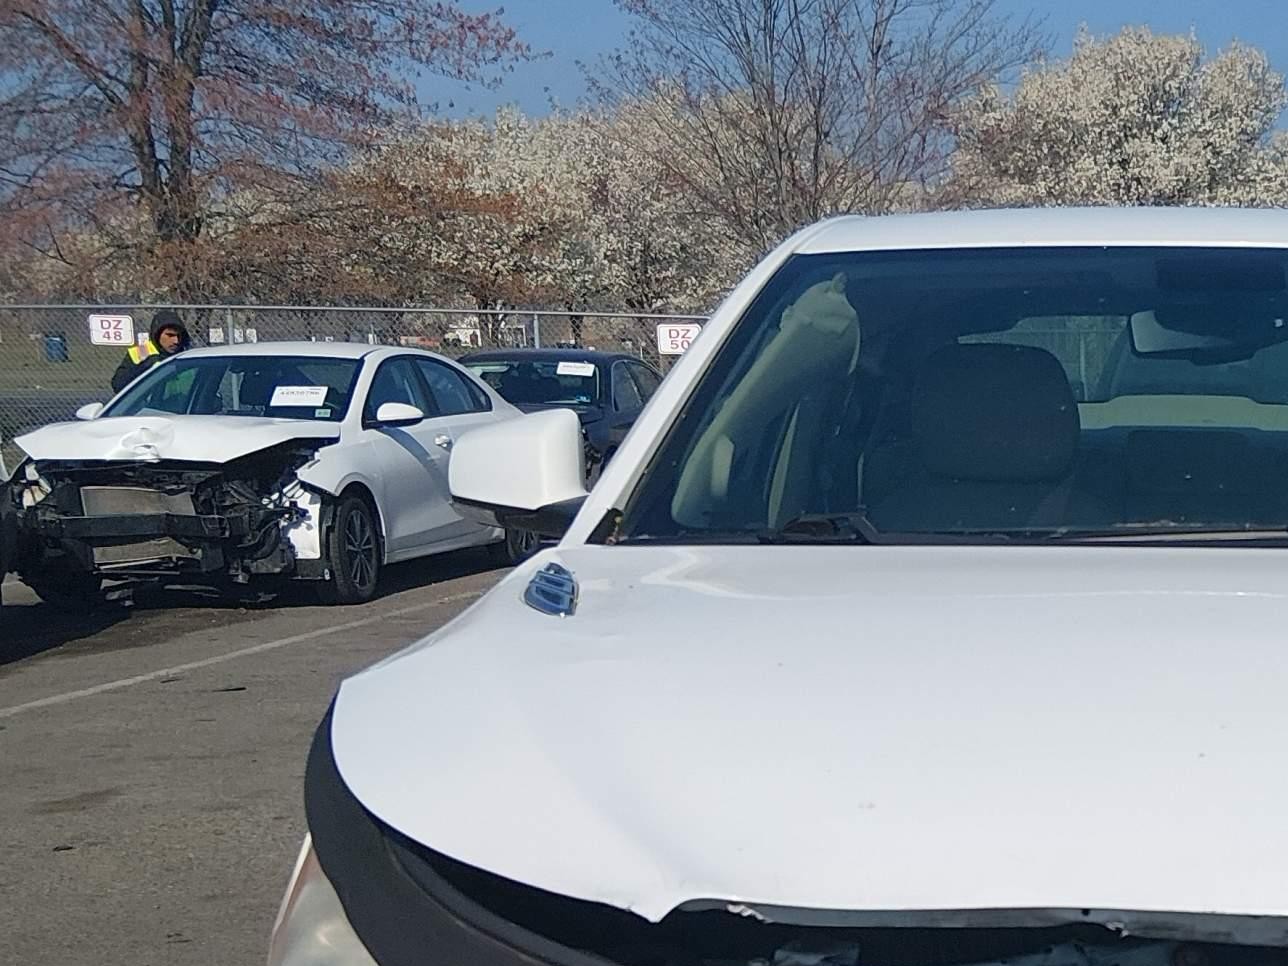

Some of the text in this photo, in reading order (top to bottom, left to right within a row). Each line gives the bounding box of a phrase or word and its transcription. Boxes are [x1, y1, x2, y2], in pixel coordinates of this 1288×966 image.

[100, 319, 123, 330] DZ
[102, 331, 122, 341] 48
[668, 328, 692, 339] DZ
